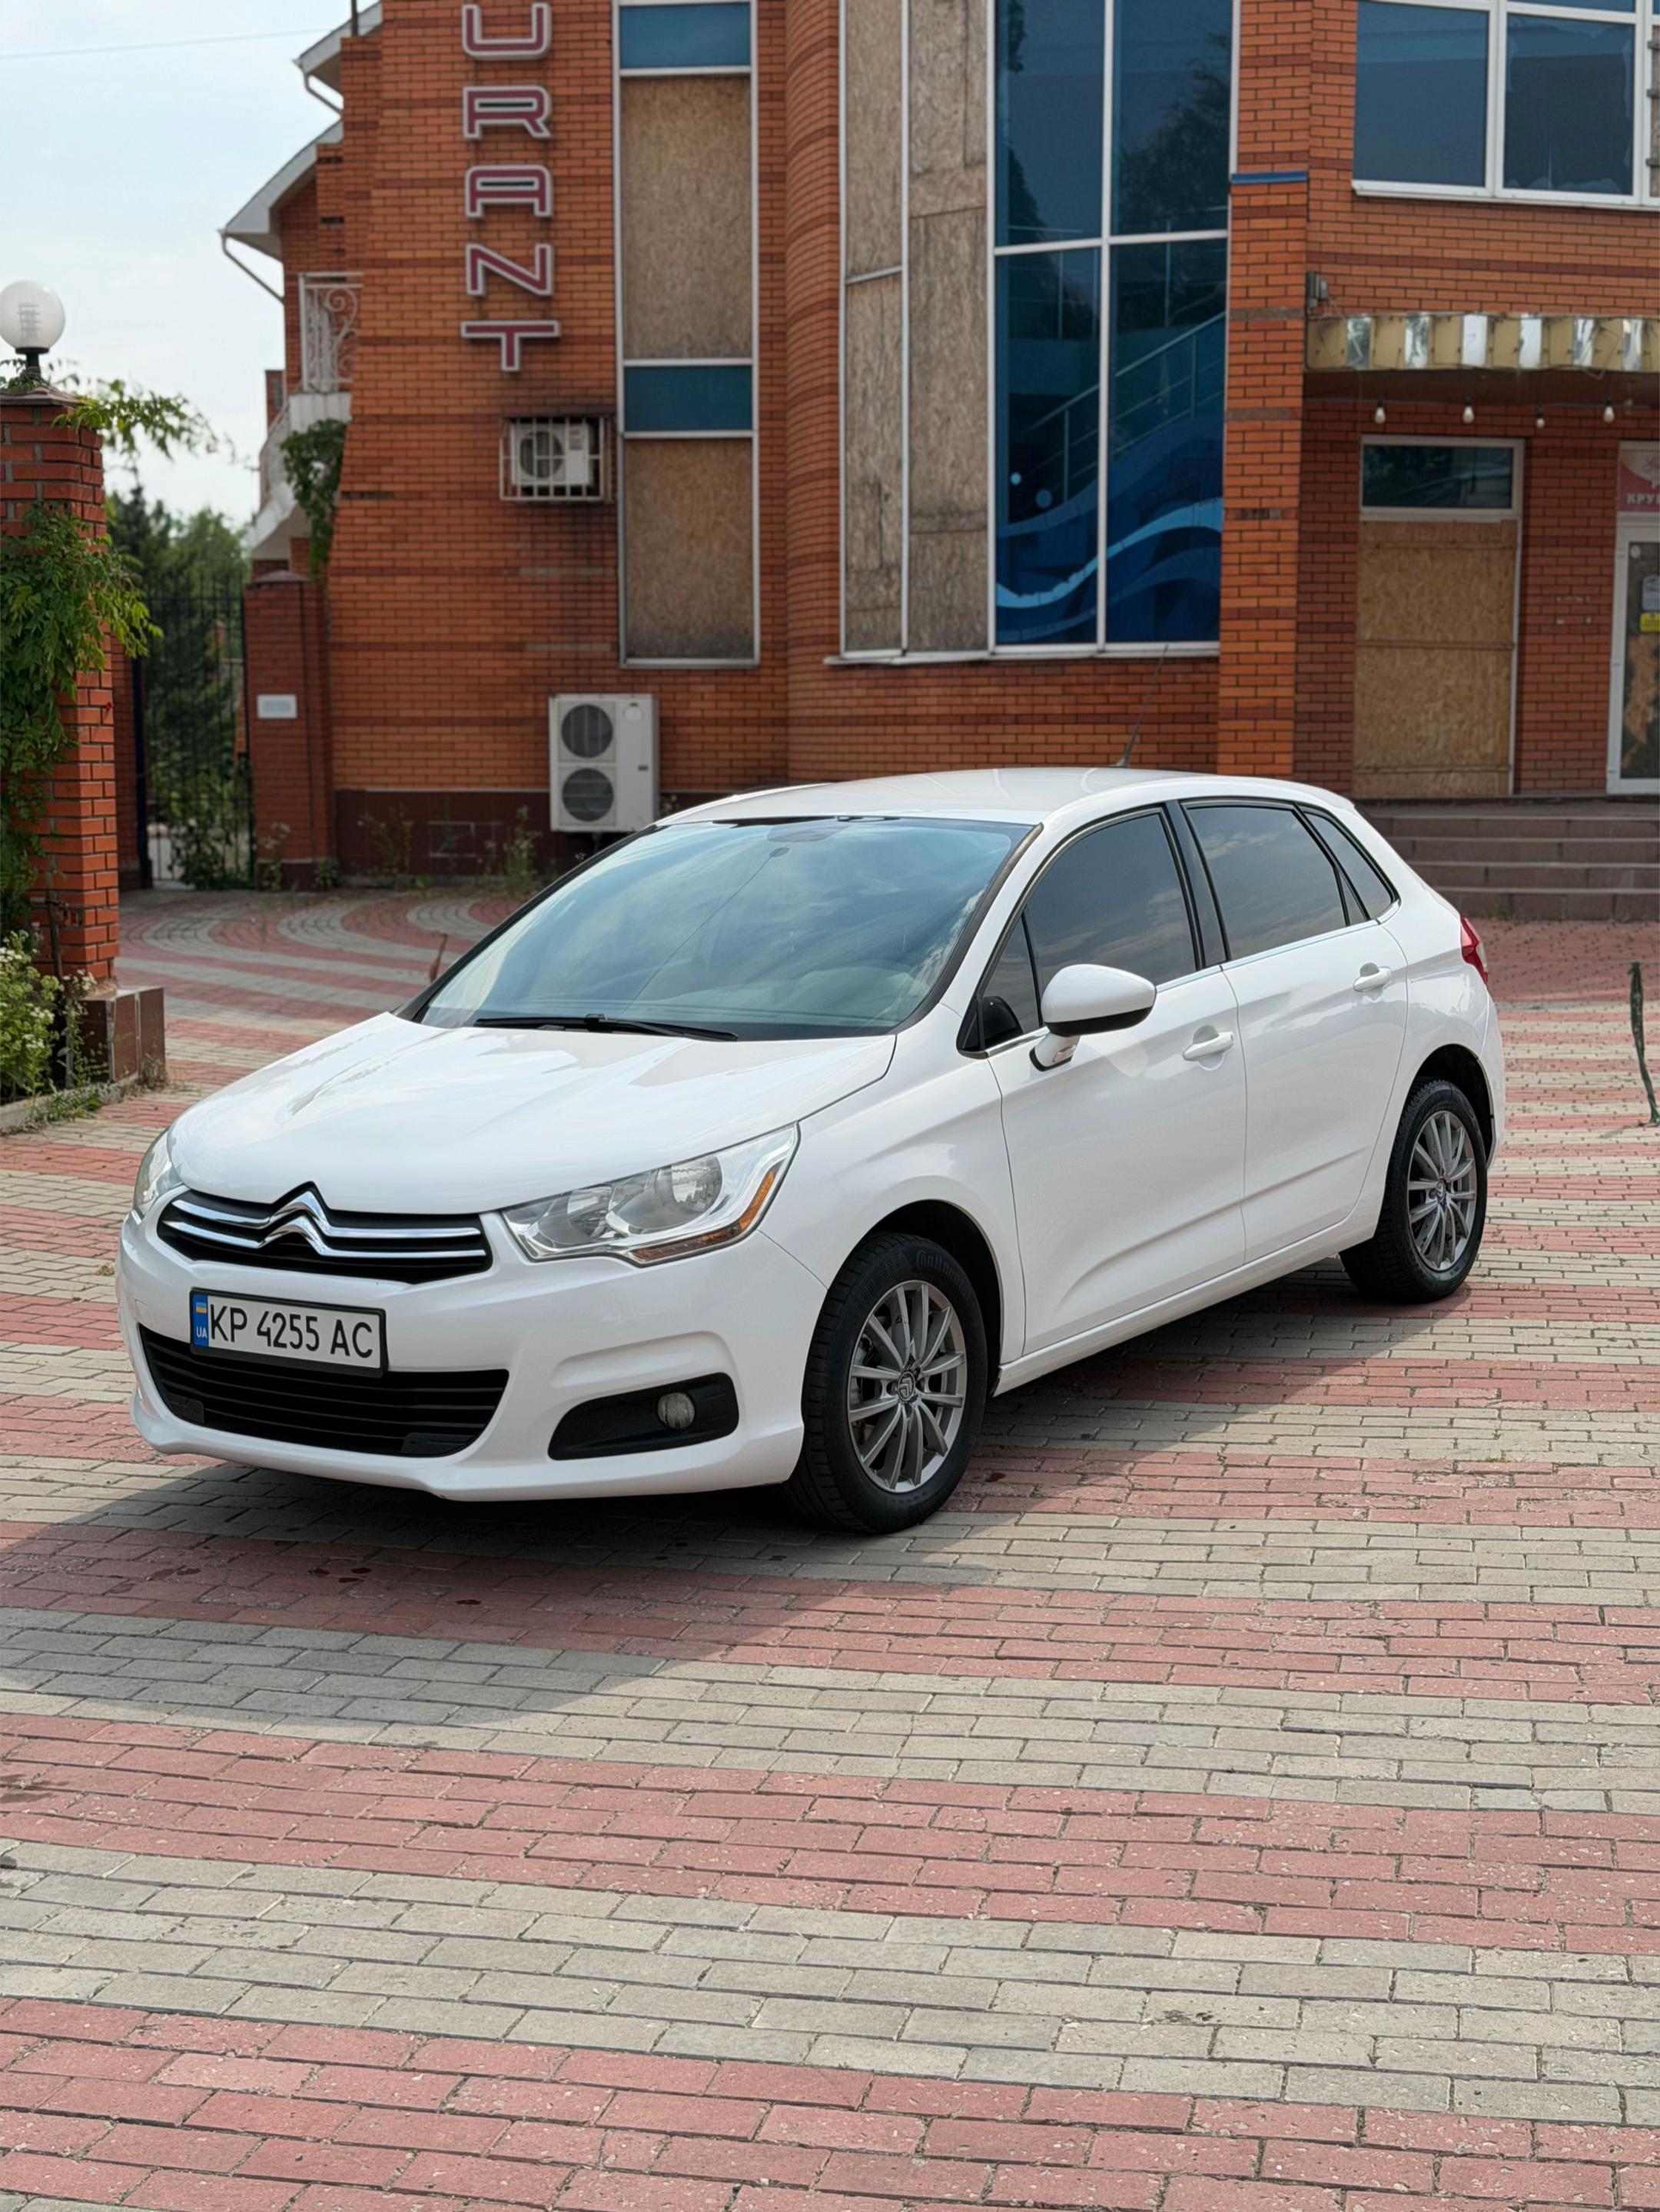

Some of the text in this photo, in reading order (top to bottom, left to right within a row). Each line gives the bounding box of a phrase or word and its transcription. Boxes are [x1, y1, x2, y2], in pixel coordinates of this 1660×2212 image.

[196, 1327, 208, 1339] UA
[210, 1304, 374, 1359] KP 4255 AC
